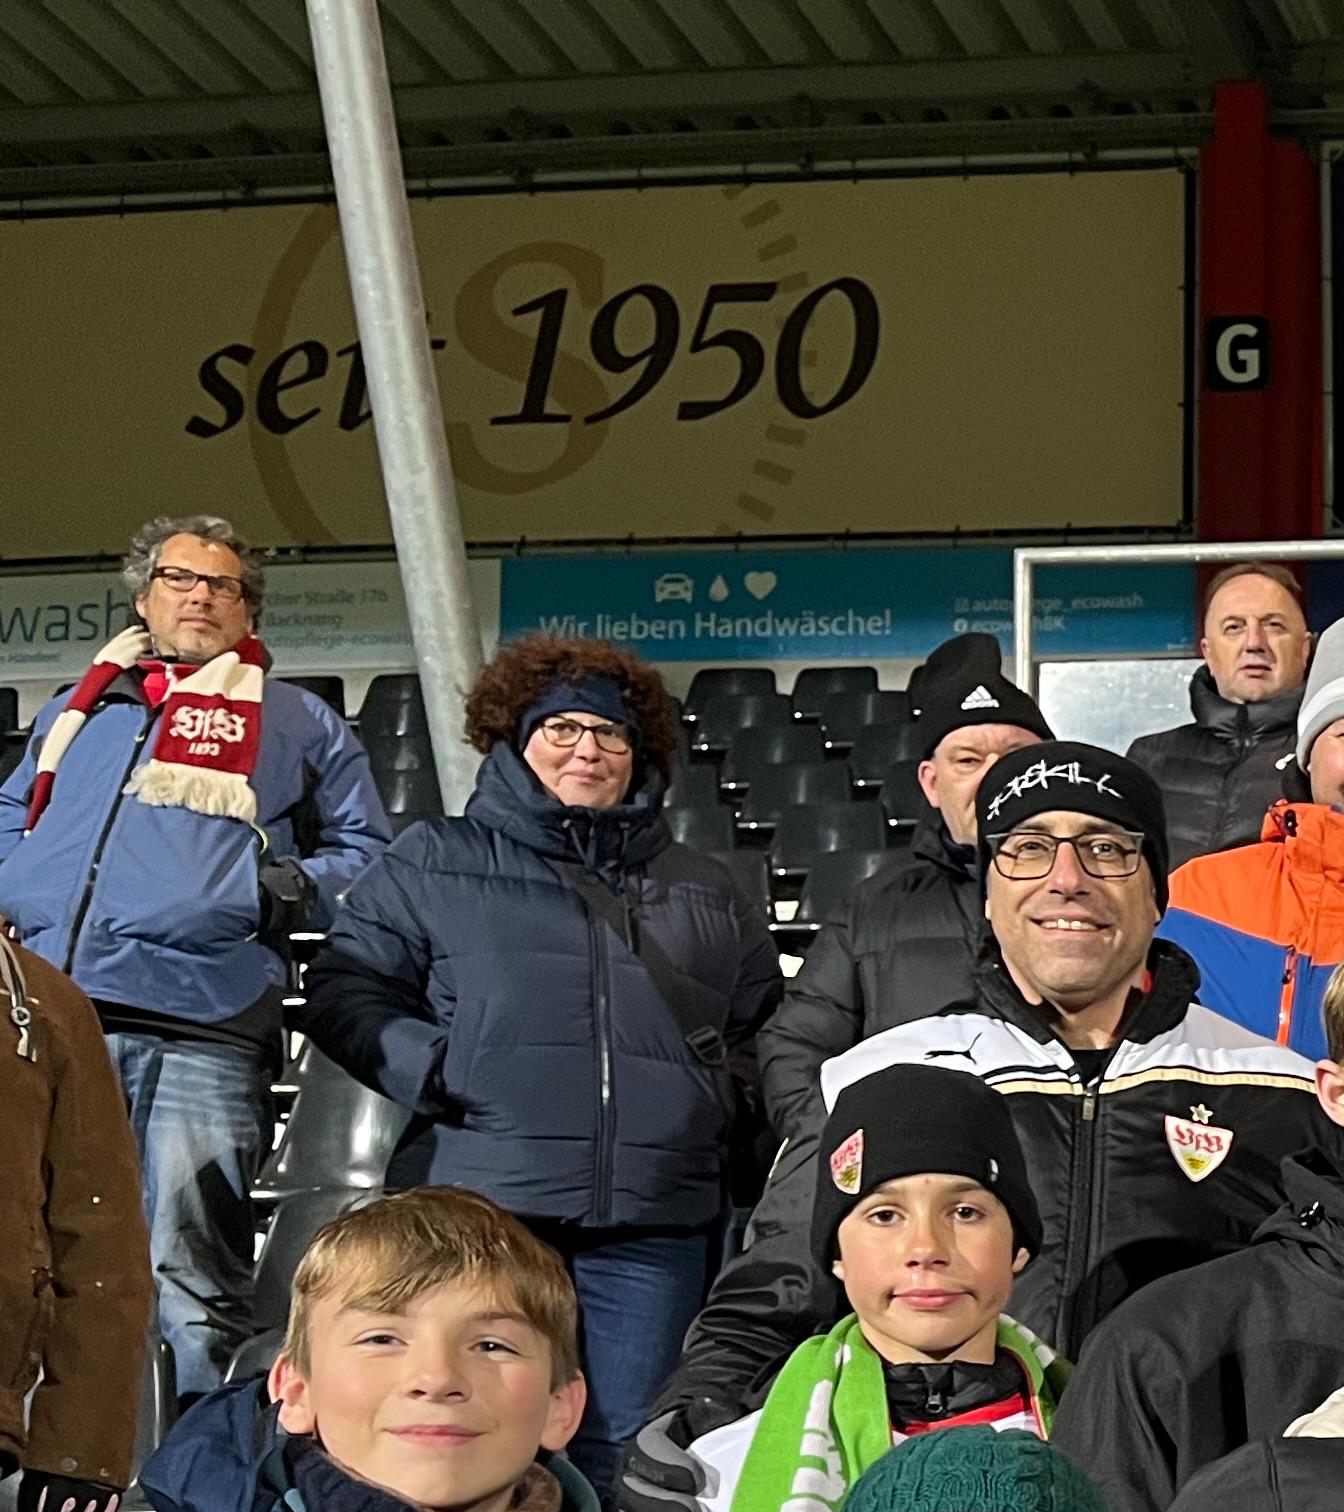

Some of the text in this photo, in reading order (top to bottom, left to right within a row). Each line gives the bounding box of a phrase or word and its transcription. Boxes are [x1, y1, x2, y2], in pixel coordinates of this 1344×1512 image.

[489, 276, 881, 427] 1950
[1215, 322, 1260, 384] G
[538, 608, 892, 640] Wir lieben Handwäsche!
